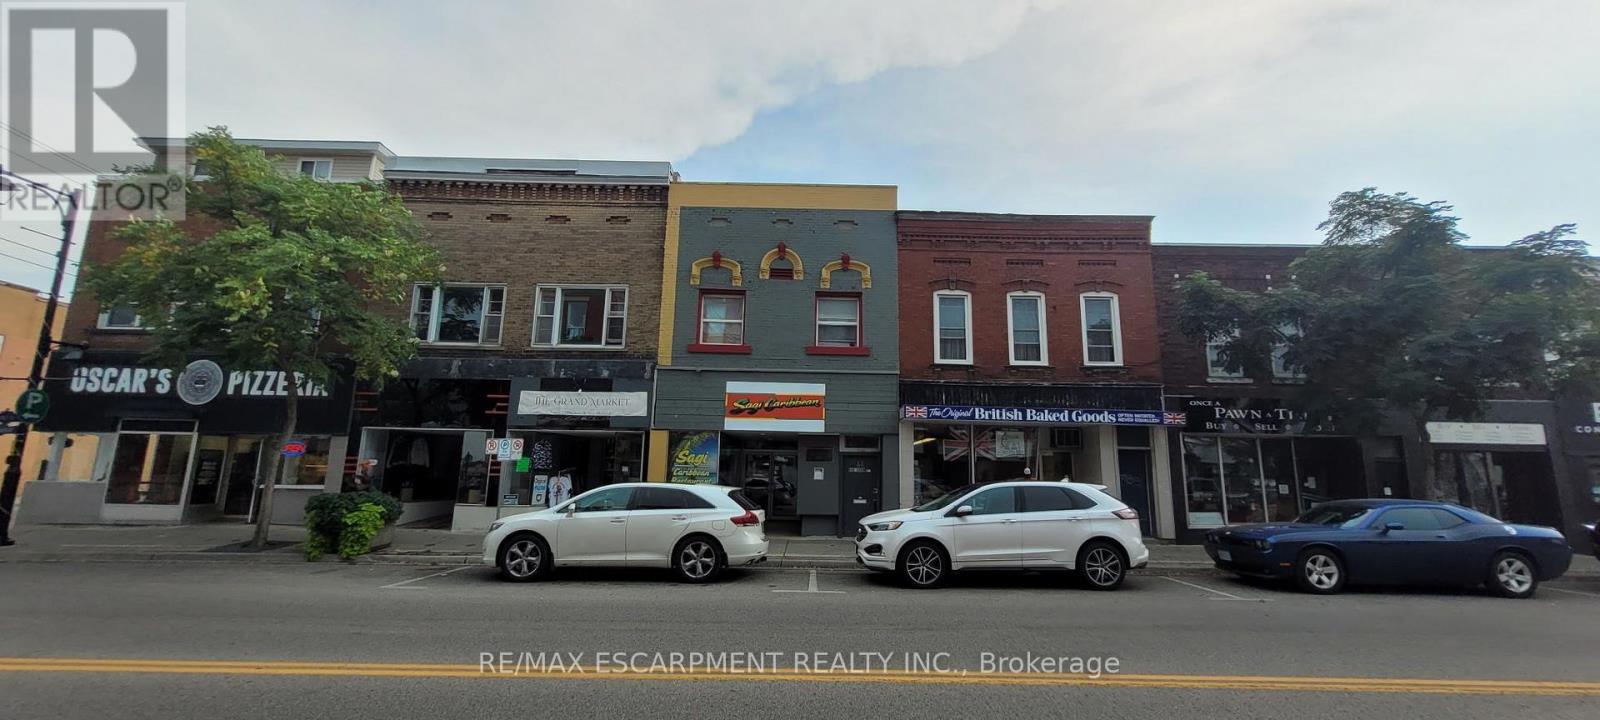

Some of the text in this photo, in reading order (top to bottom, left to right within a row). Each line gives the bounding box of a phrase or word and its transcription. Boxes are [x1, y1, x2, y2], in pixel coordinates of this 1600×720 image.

[70, 367, 172, 393] OSCAR'S
[553, 396, 588, 406] GRAND
[590, 398, 630, 407] MARKET
[764, 397, 820, 411] Caribbean
[929, 408, 1116, 423] The Original British Baked Goods
[1214, 407, 1262, 419] PAWN
[1206, 422, 1280, 431] BUY SELL
[676, 451, 708, 465] Sagi
[673, 467, 709, 476] Caribbean
